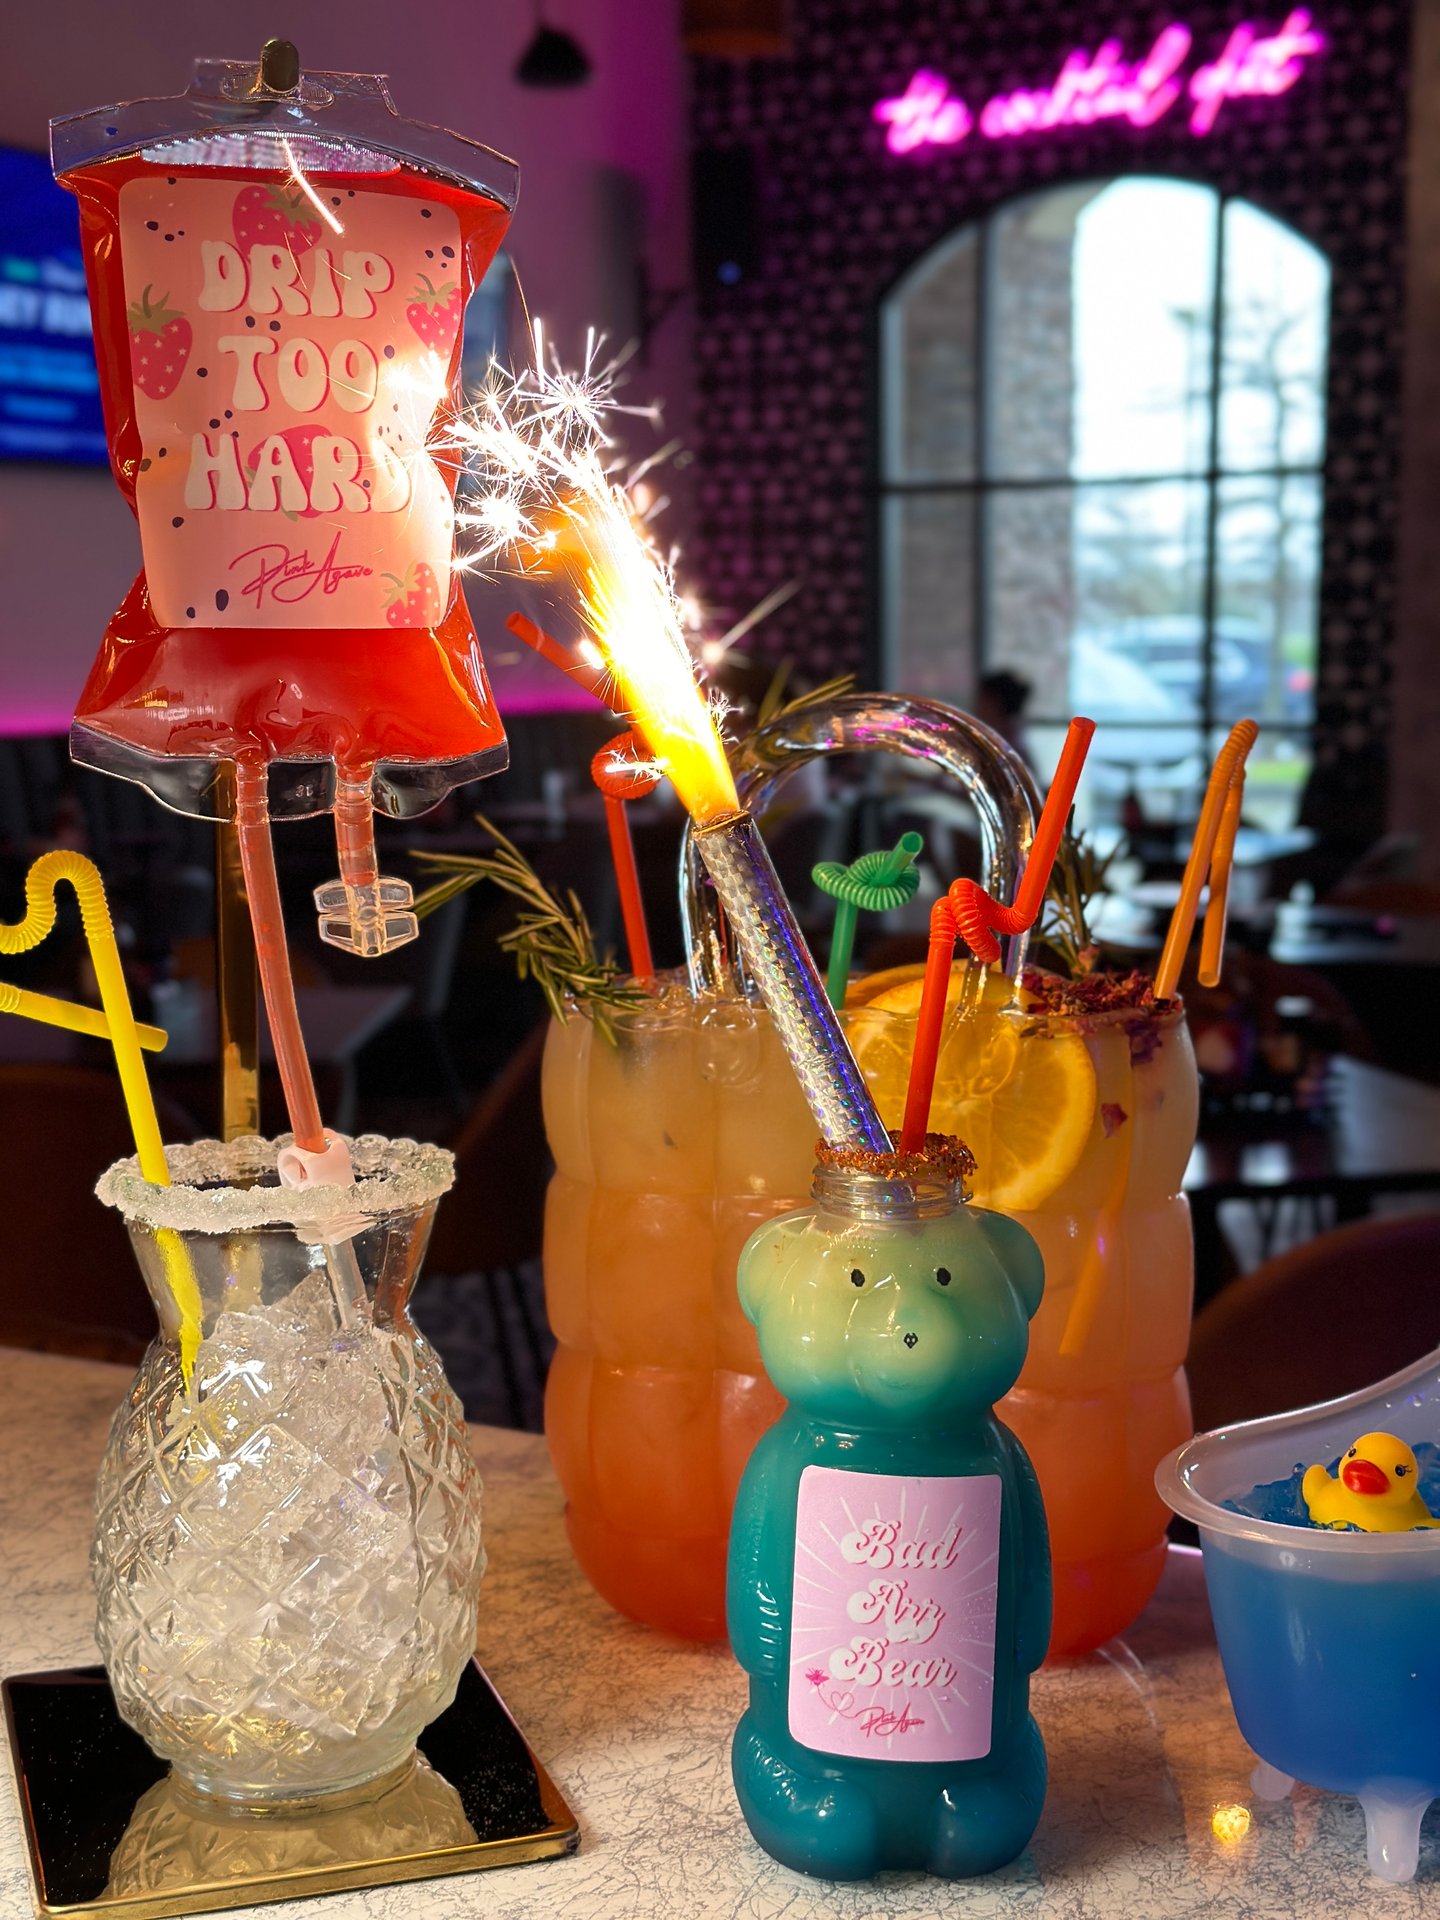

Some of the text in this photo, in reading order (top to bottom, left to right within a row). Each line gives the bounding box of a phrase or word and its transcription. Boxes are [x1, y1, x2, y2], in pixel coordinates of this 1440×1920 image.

[199, 240, 395, 319] DRIP
[217, 335, 380, 413] TOO
[184, 432, 412, 513] HARD
[228, 530, 374, 609] Pink Agave
[840, 1518, 962, 1570] Bad
[828, 1635, 958, 1688] Bear
